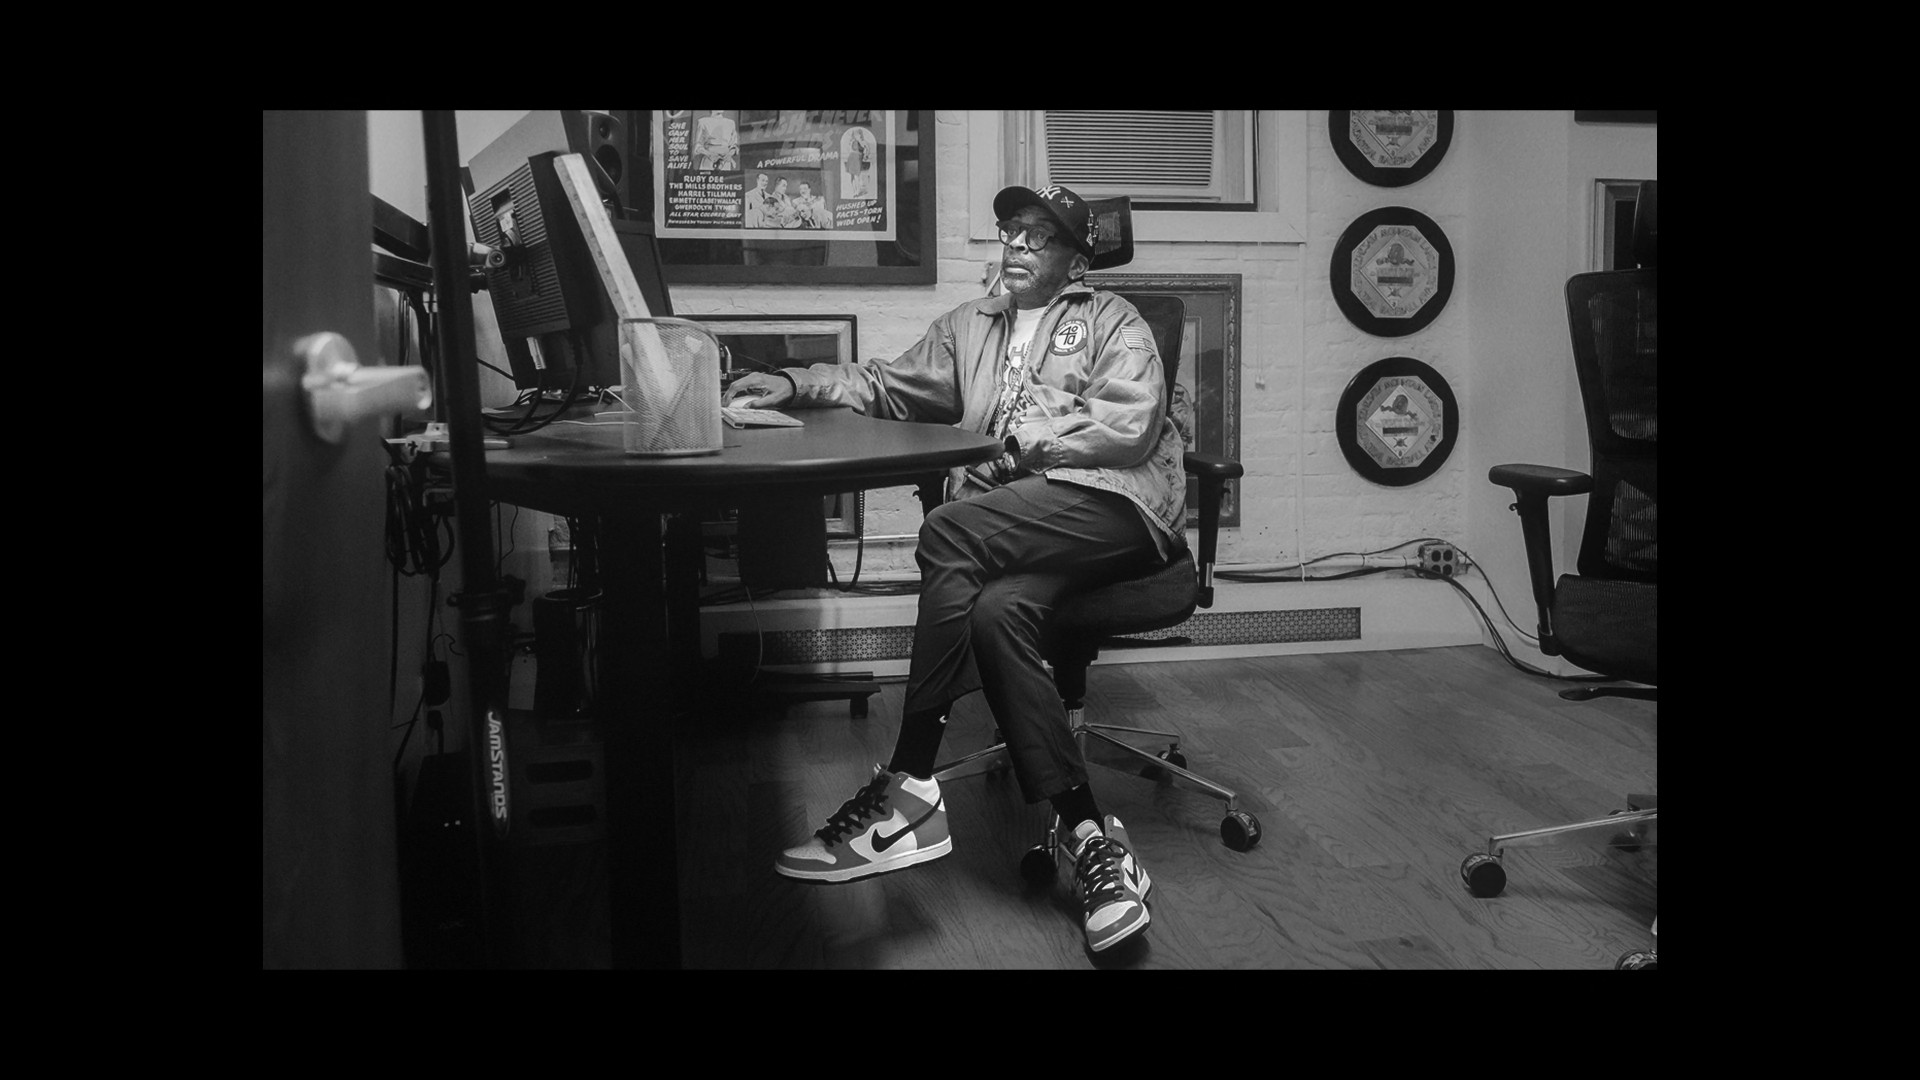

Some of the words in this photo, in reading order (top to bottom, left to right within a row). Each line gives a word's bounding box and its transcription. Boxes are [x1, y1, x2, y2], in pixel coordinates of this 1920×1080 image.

[668, 122, 686, 130] SHE
[757, 161, 763, 169] A
[764, 155, 806, 167] POWERFUL
[808, 151, 839, 162] DRAMA
[683, 175, 707, 183] RUBY
[708, 175, 724, 183] DEE
[669, 182, 684, 190] THE
[707, 183, 743, 191] BROTHERS
[678, 190, 706, 198] HARREL
[836, 201, 866, 211] HUSHED
[837, 218, 855, 227] WIDE
[856, 214, 881, 224] OPEN!
